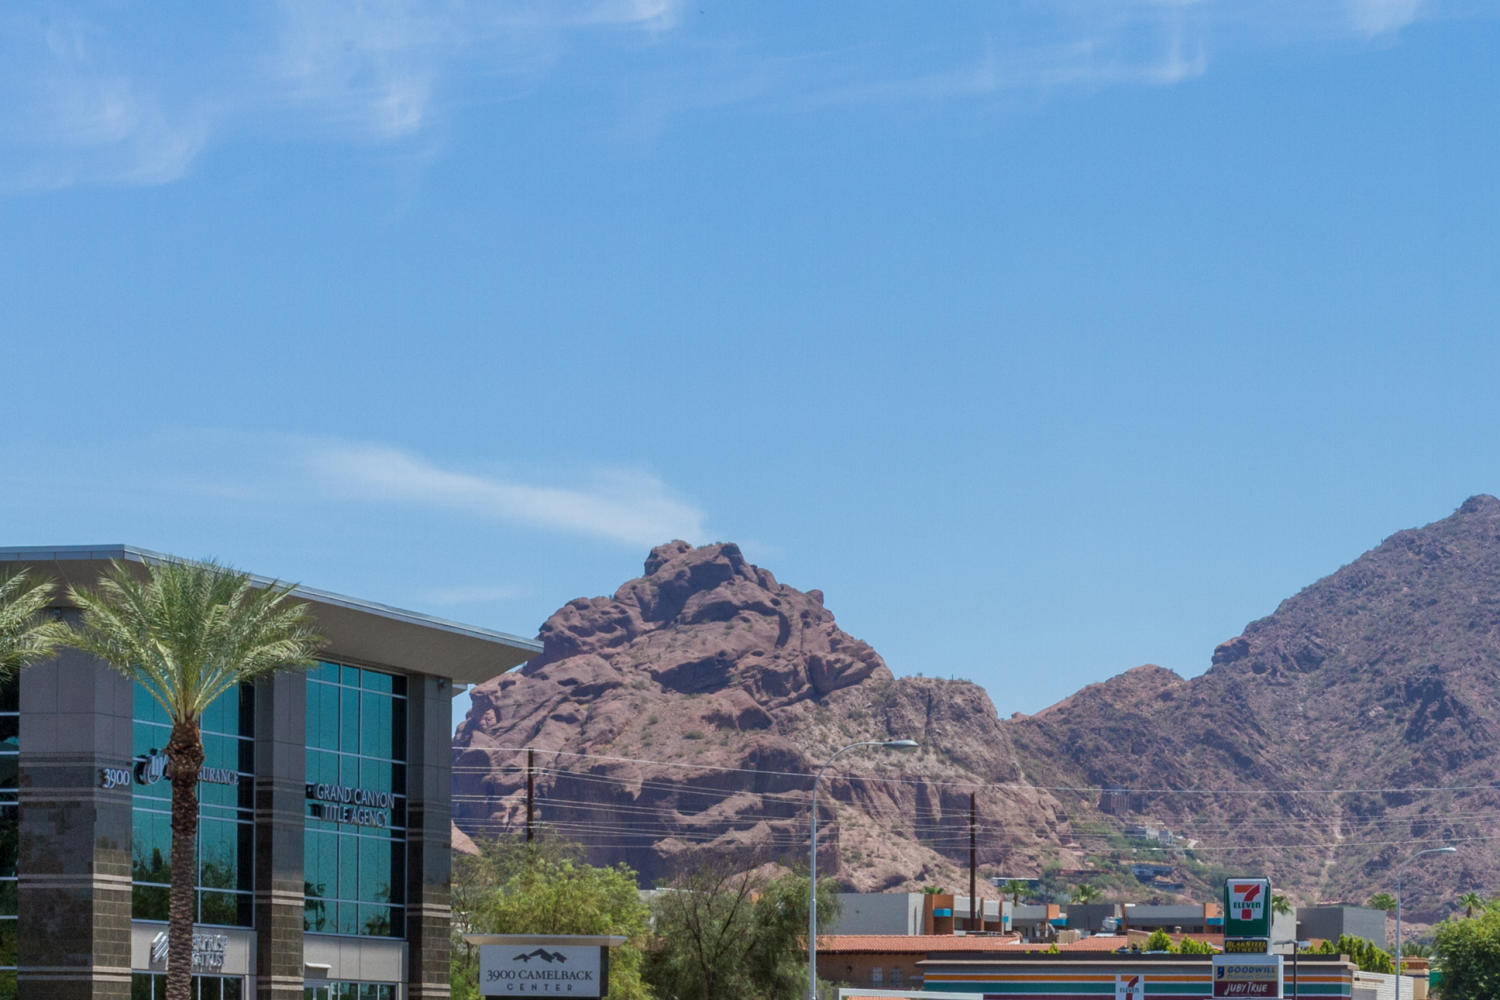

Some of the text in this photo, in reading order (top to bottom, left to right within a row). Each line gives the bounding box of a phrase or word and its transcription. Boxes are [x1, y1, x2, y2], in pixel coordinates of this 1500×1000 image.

[103, 768, 130, 789] 3900
[316, 783, 395, 809] GRAND CANYON
[323, 804, 389, 827] TITLE AGENCY
[1234, 884, 1260, 920] 7
[487, 970, 593, 982] 3900 CAMELBACK
[506, 983, 573, 992] CENTER
